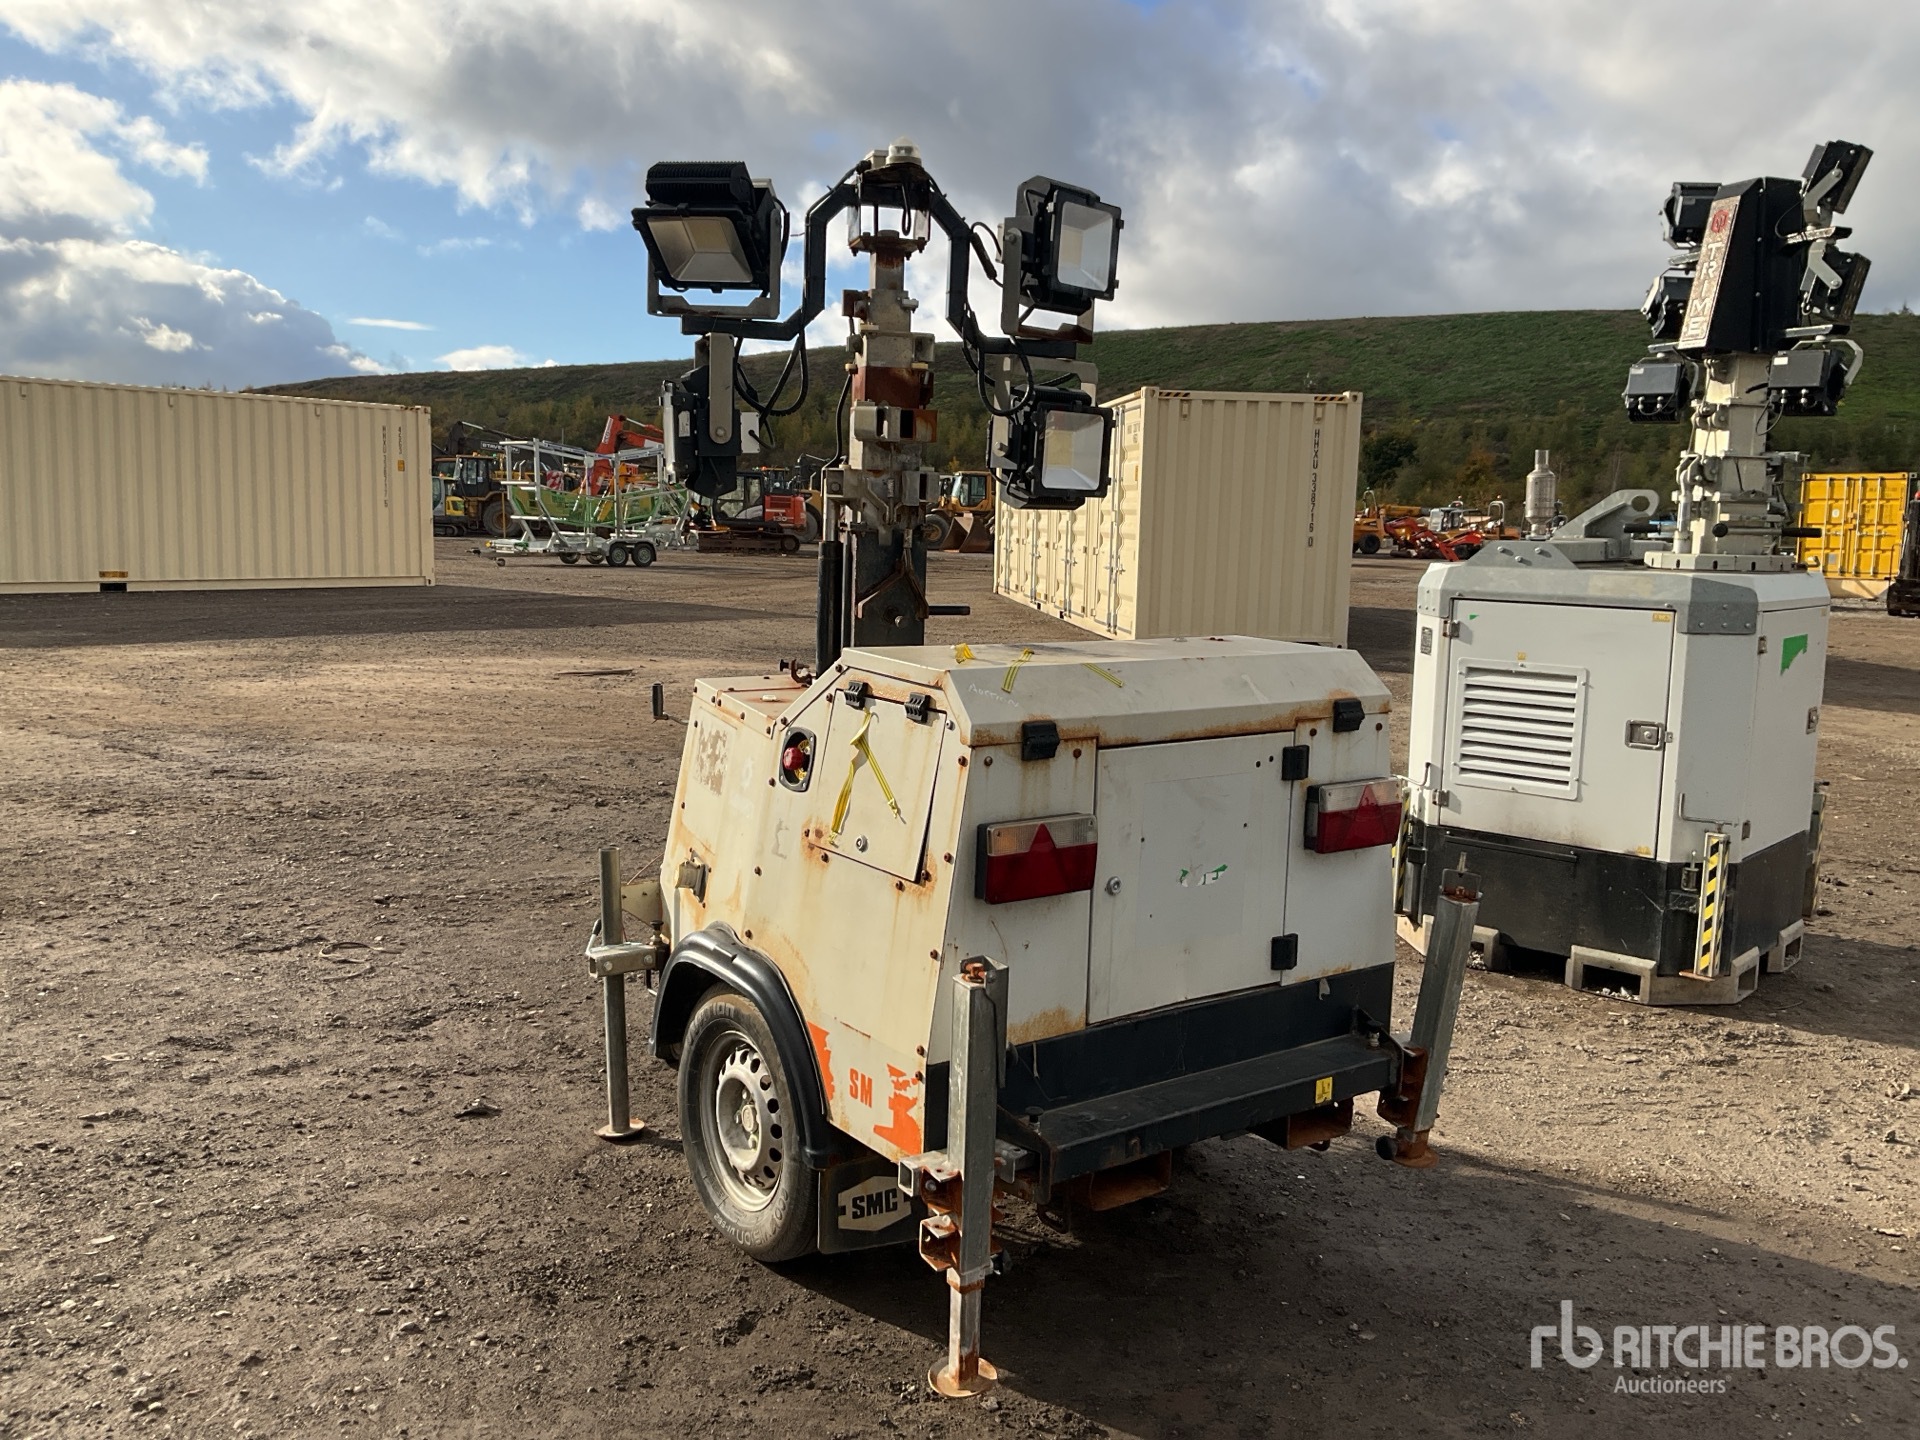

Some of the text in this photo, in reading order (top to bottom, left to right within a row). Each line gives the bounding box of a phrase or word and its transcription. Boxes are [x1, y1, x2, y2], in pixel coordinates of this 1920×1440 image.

[1687, 240, 1725, 336] TRIME
[1312, 428, 1321, 470] HHXU
[1307, 472, 1318, 532] 338716
[852, 1187, 898, 1220] SMC
